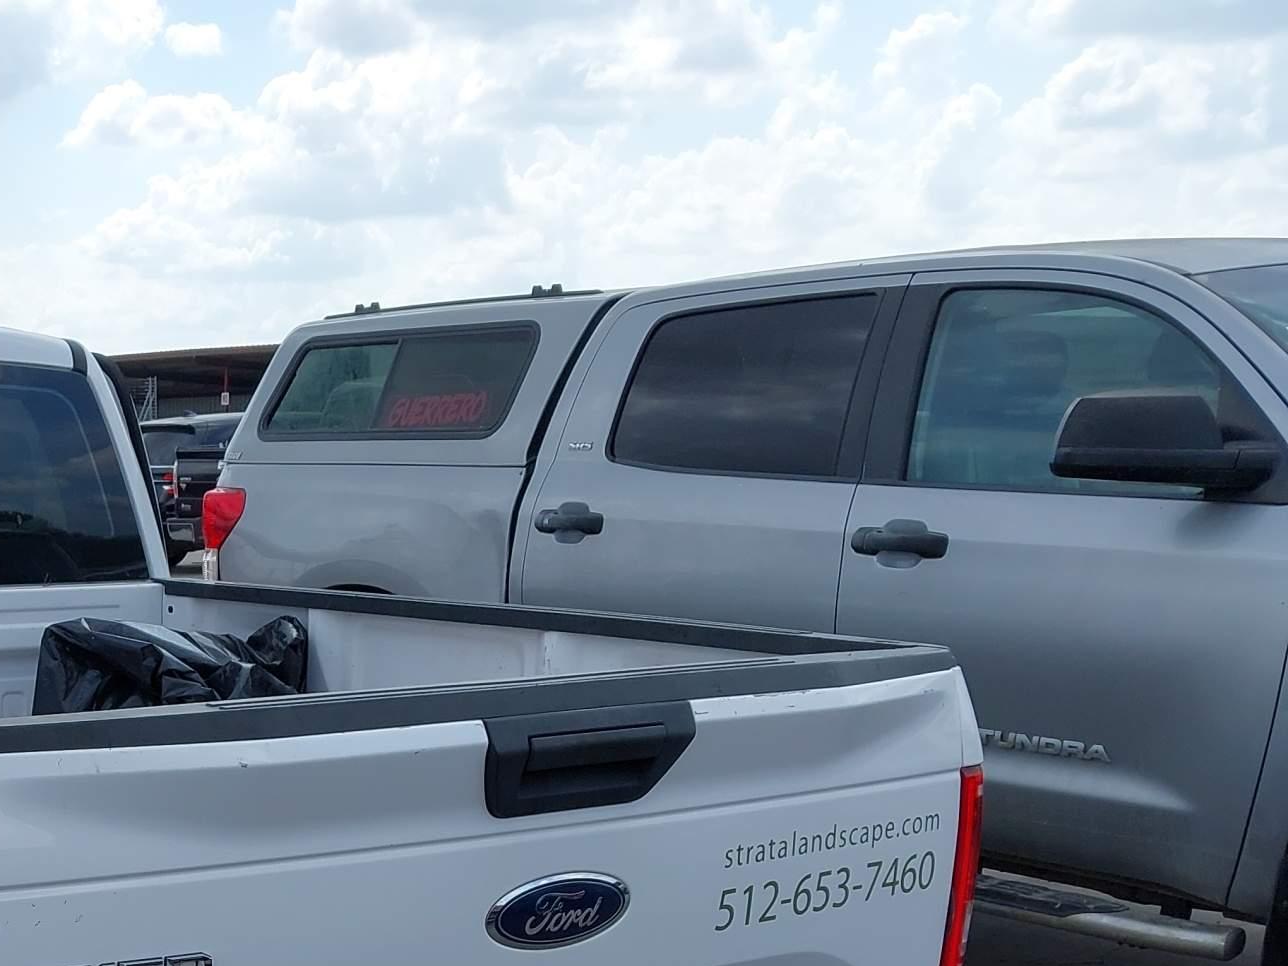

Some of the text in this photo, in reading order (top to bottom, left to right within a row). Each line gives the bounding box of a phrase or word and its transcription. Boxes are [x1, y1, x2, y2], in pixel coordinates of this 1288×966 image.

[978, 727, 1112, 763] TUNDRA
[724, 811, 941, 870] stratalandscape.com
[525, 889, 603, 937] Ford
[714, 850, 937, 933] 512-653-7460
